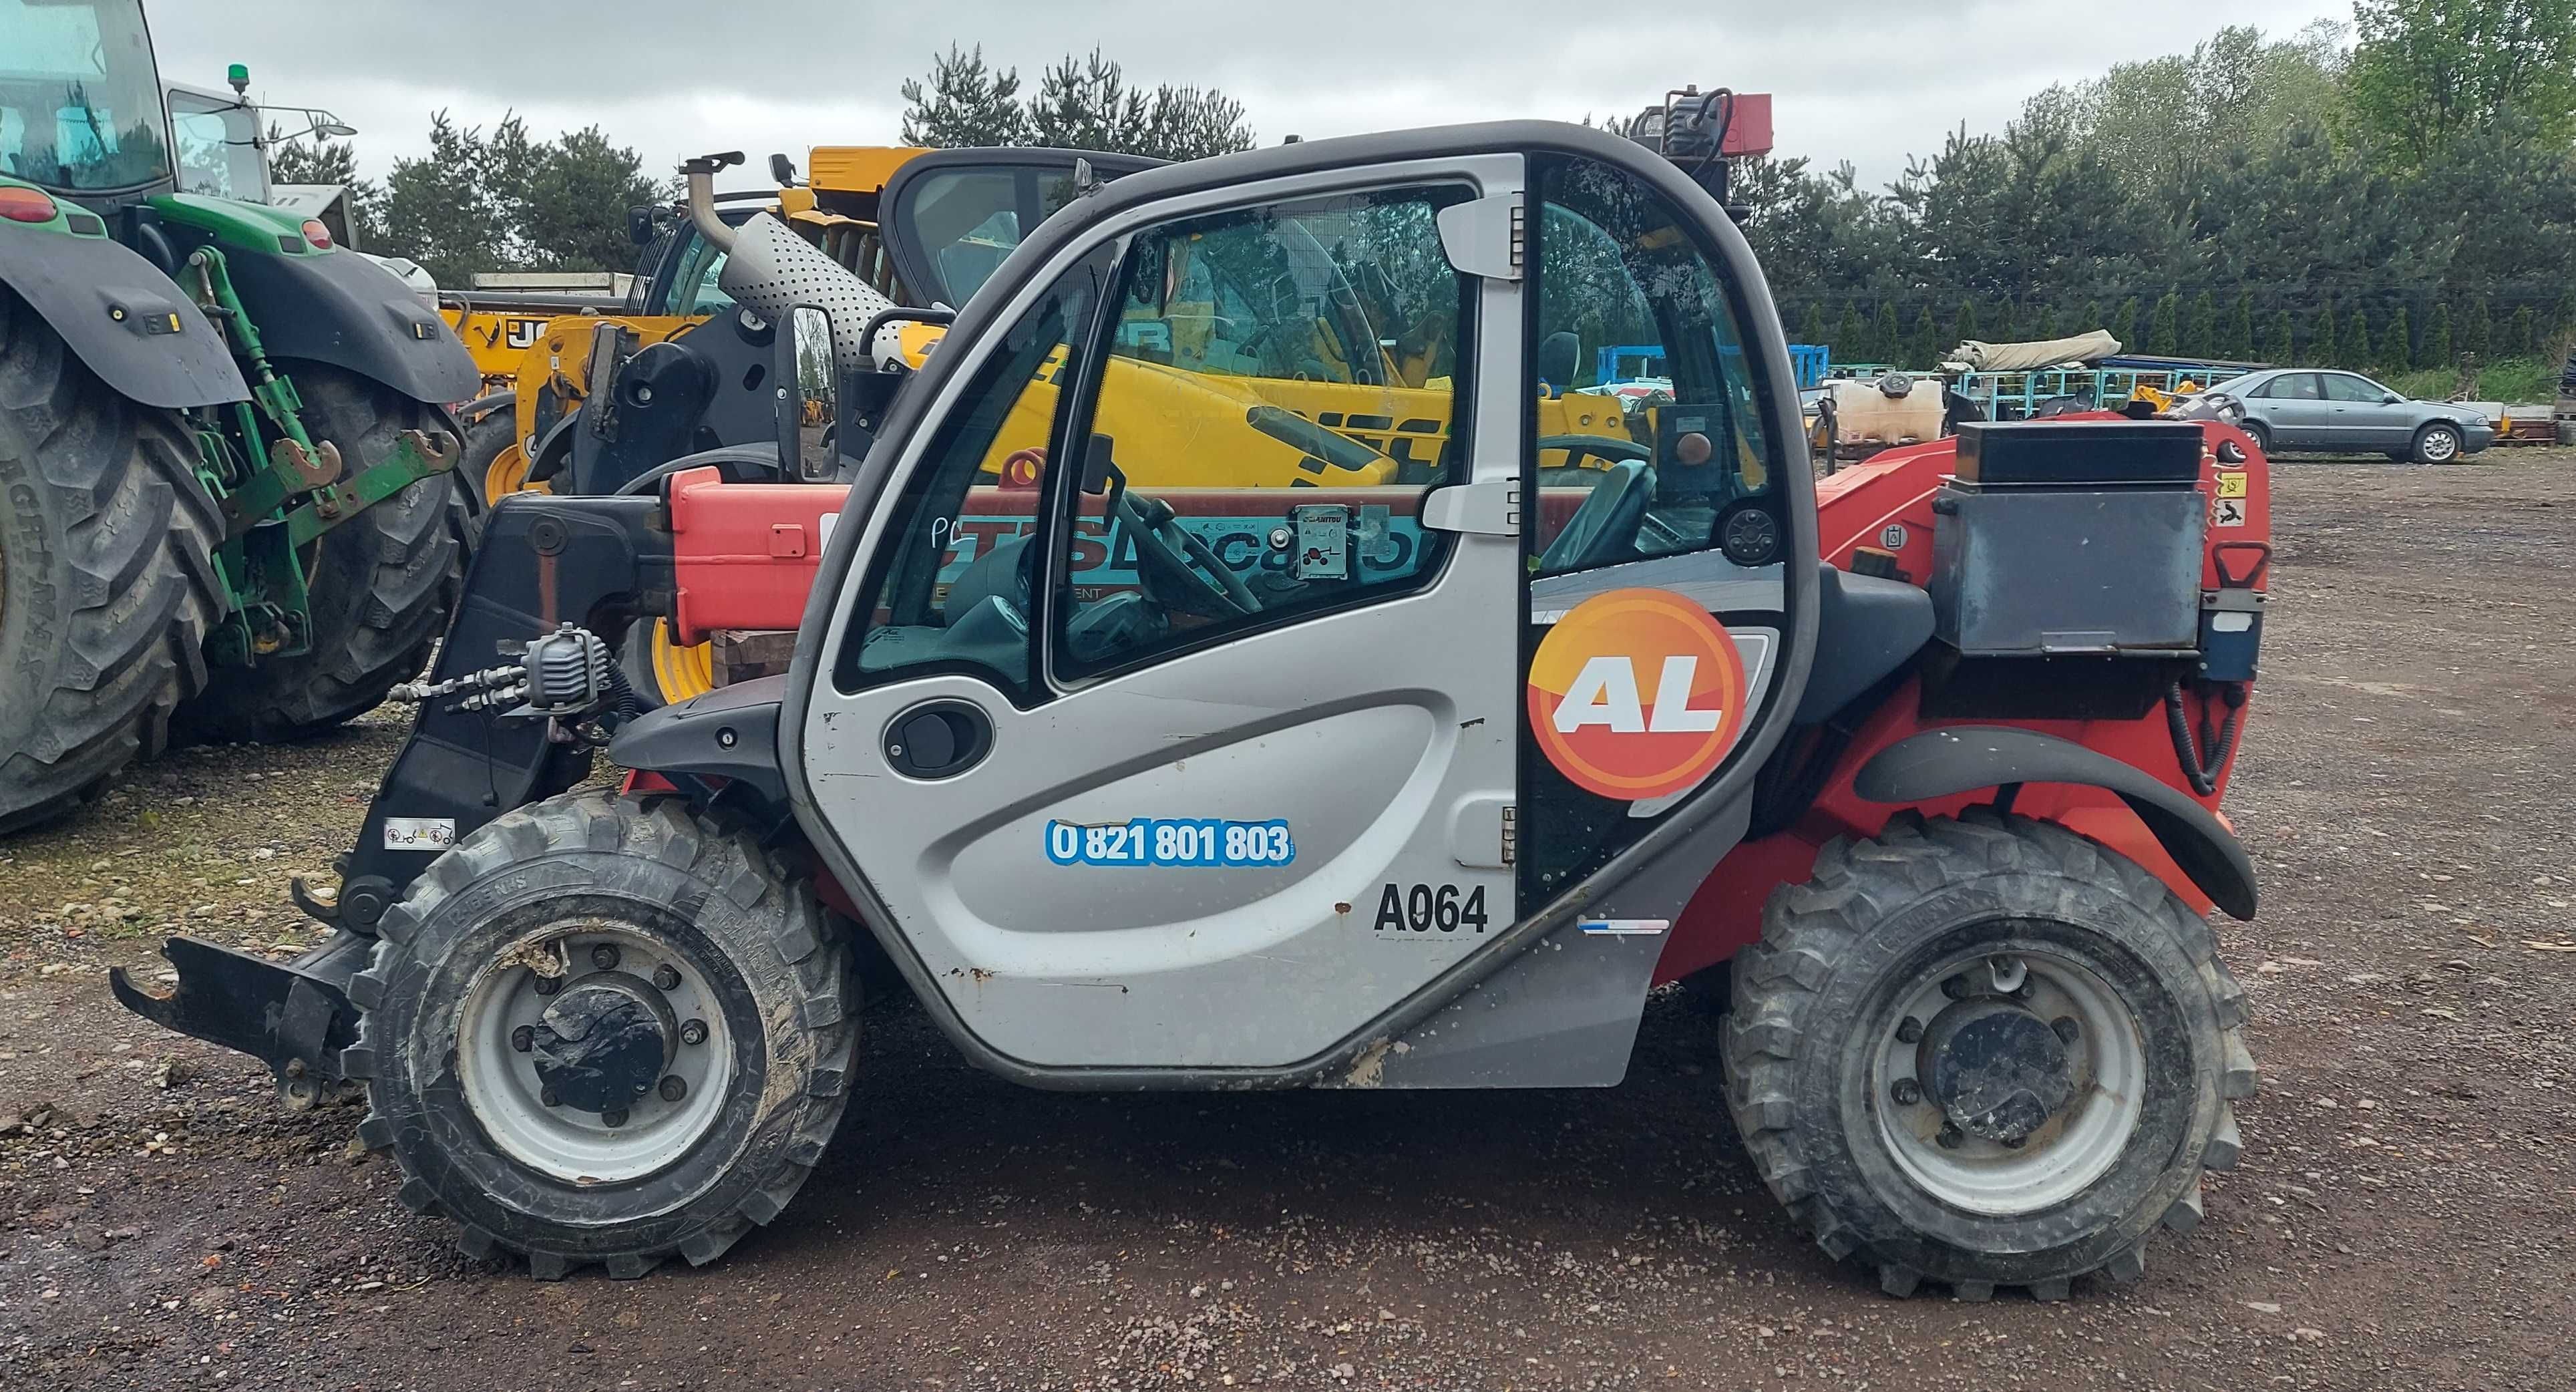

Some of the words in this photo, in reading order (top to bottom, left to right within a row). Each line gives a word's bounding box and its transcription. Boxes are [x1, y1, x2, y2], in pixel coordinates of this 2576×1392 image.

[1117, 323, 1170, 353] B
[1073, 588, 1102, 598] ENT
[1552, 656, 1722, 733] AL
[1053, 824, 1077, 859] 0
[1086, 825, 1144, 860] 821
[1155, 826, 1214, 860] 801
[1226, 826, 1289, 861] 803
[1374, 883, 1488, 933] A064
